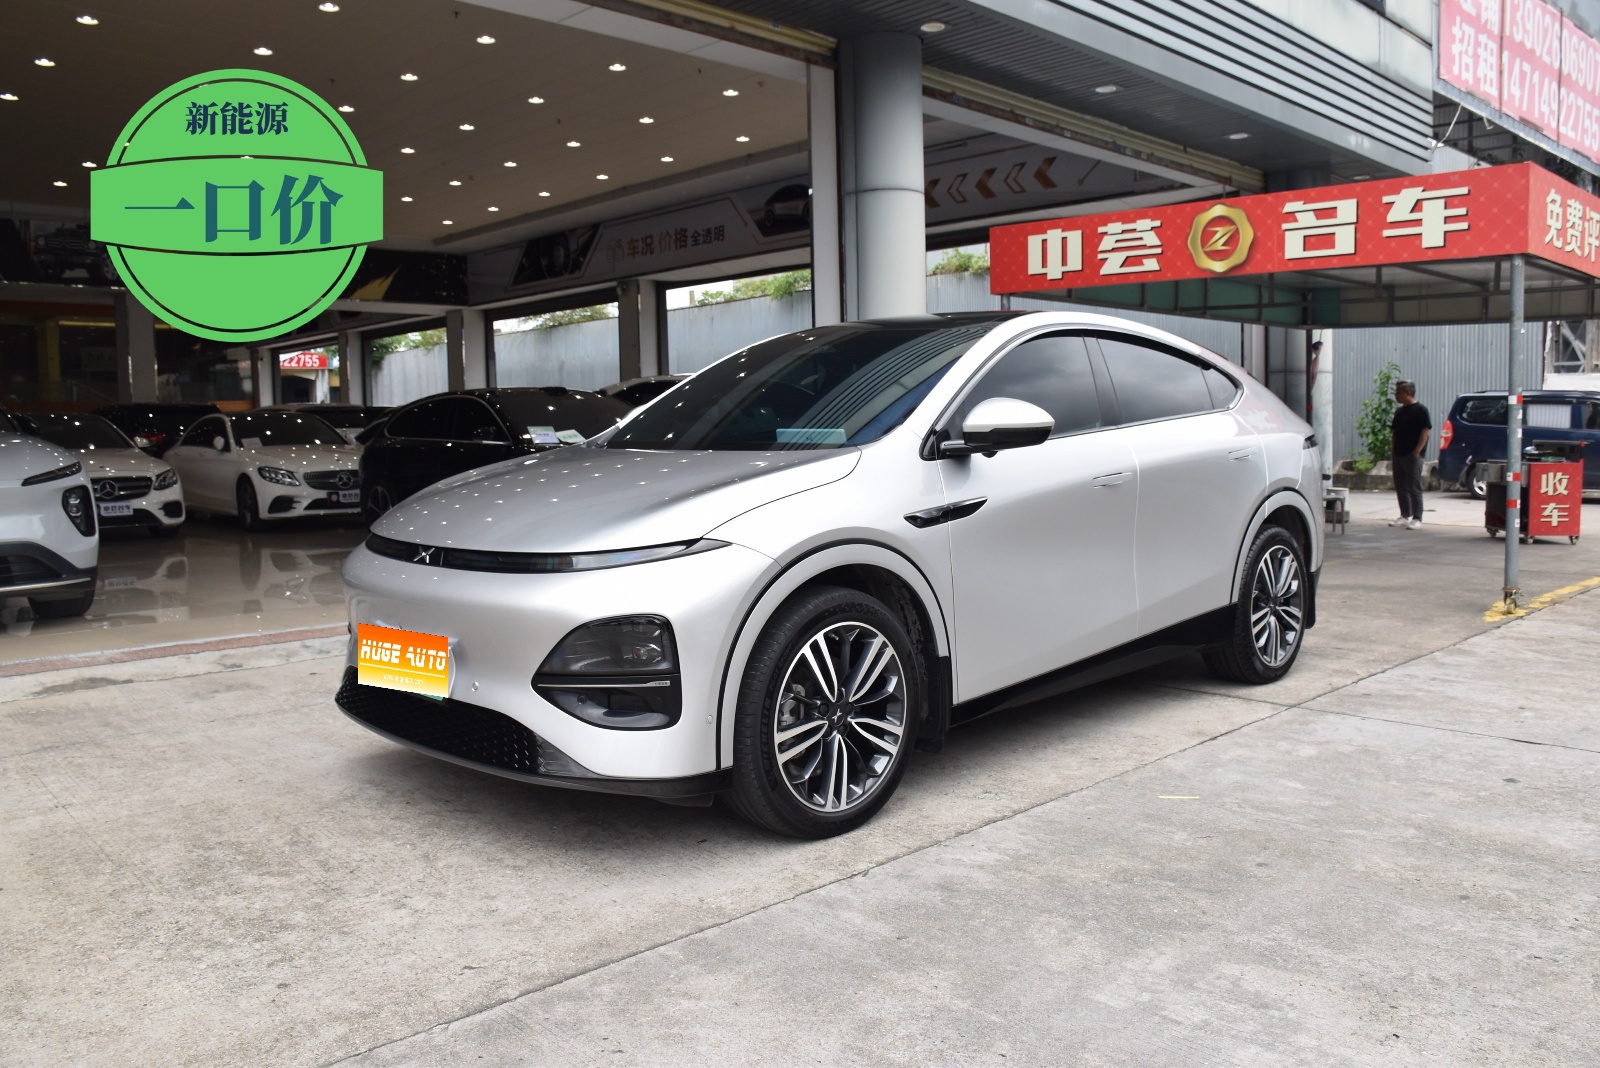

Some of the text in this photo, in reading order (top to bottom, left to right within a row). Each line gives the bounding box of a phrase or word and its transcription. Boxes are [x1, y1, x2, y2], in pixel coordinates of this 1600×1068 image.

[1452, 16, 1600, 151] 招租 14714922755
[1281, 186, 1469, 260] 名车
[1545, 188, 1600, 263] 免费评
[1540, 472, 1570, 527] 收车
